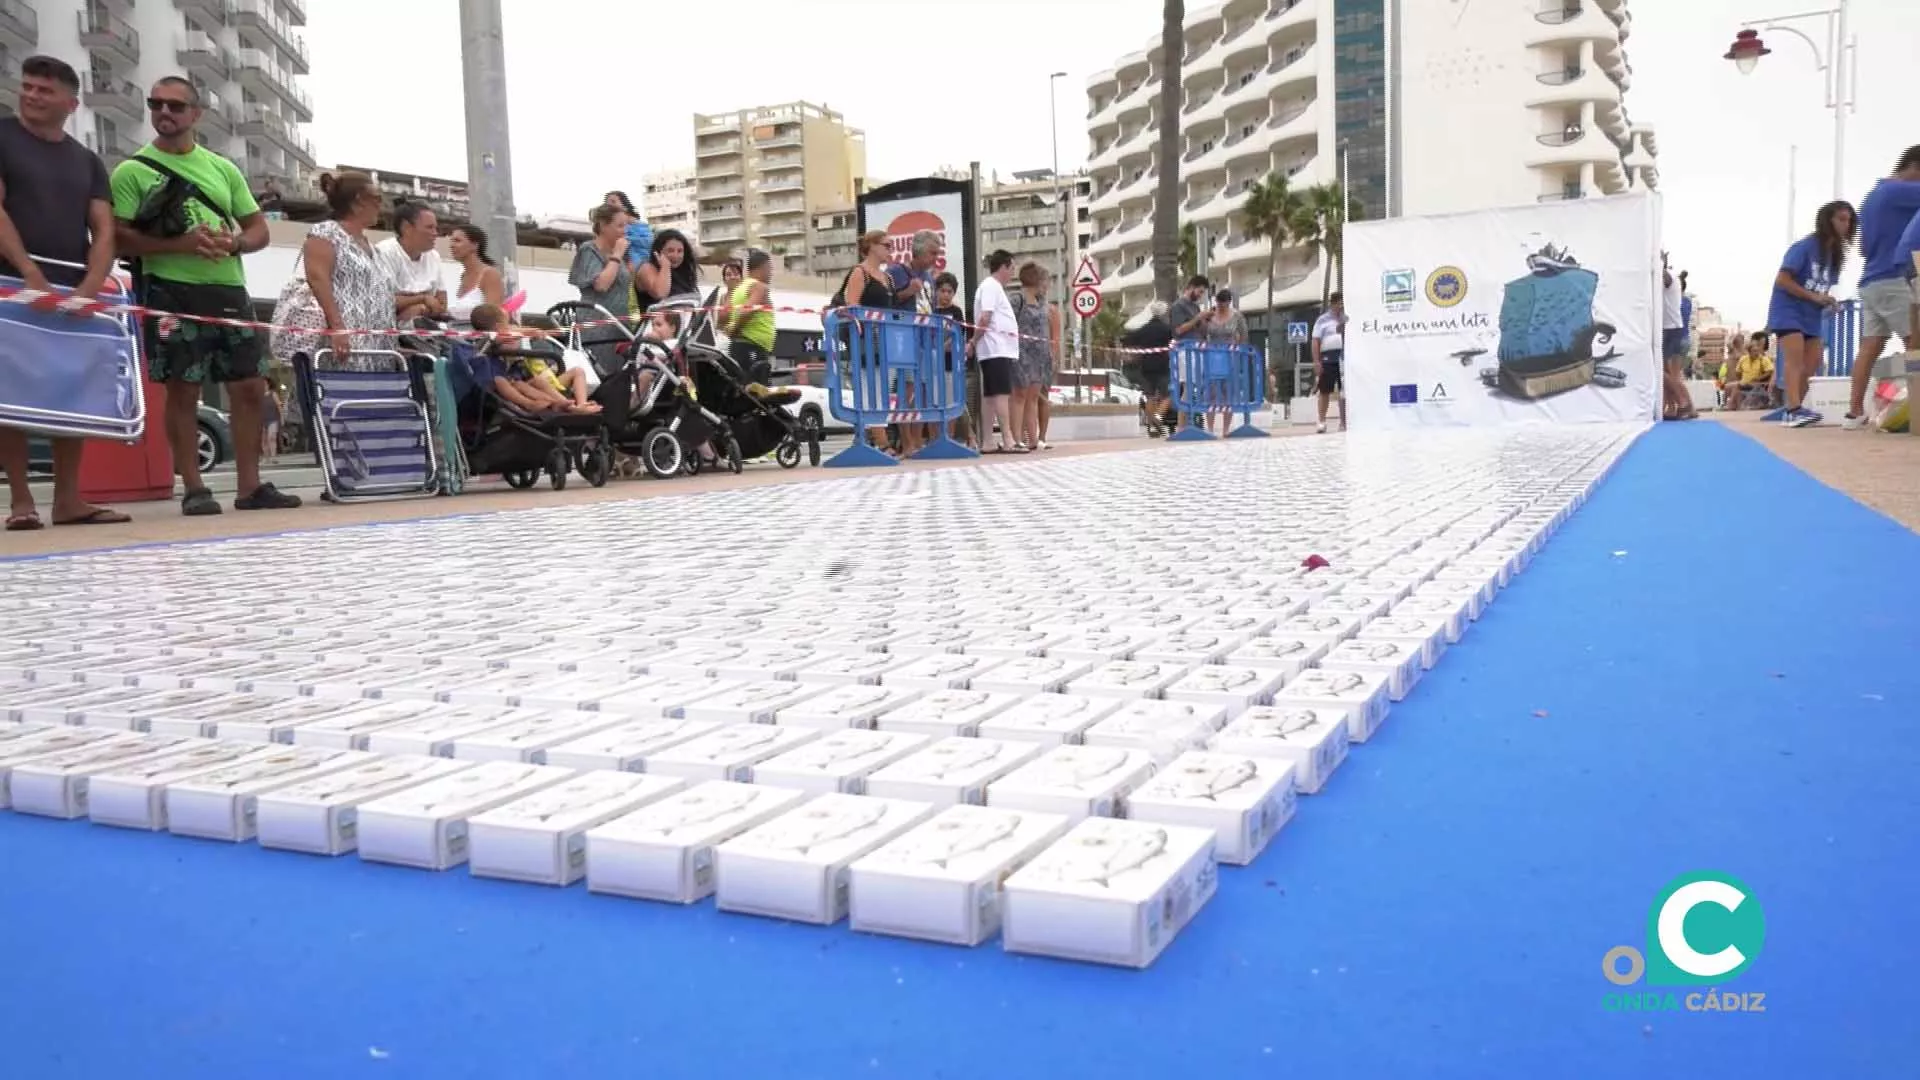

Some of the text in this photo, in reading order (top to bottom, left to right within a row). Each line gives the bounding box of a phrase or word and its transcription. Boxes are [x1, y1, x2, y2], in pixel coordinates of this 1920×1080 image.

[1079, 296, 1095, 307] 30
[1362, 311, 1489, 334] El mar en una lata
